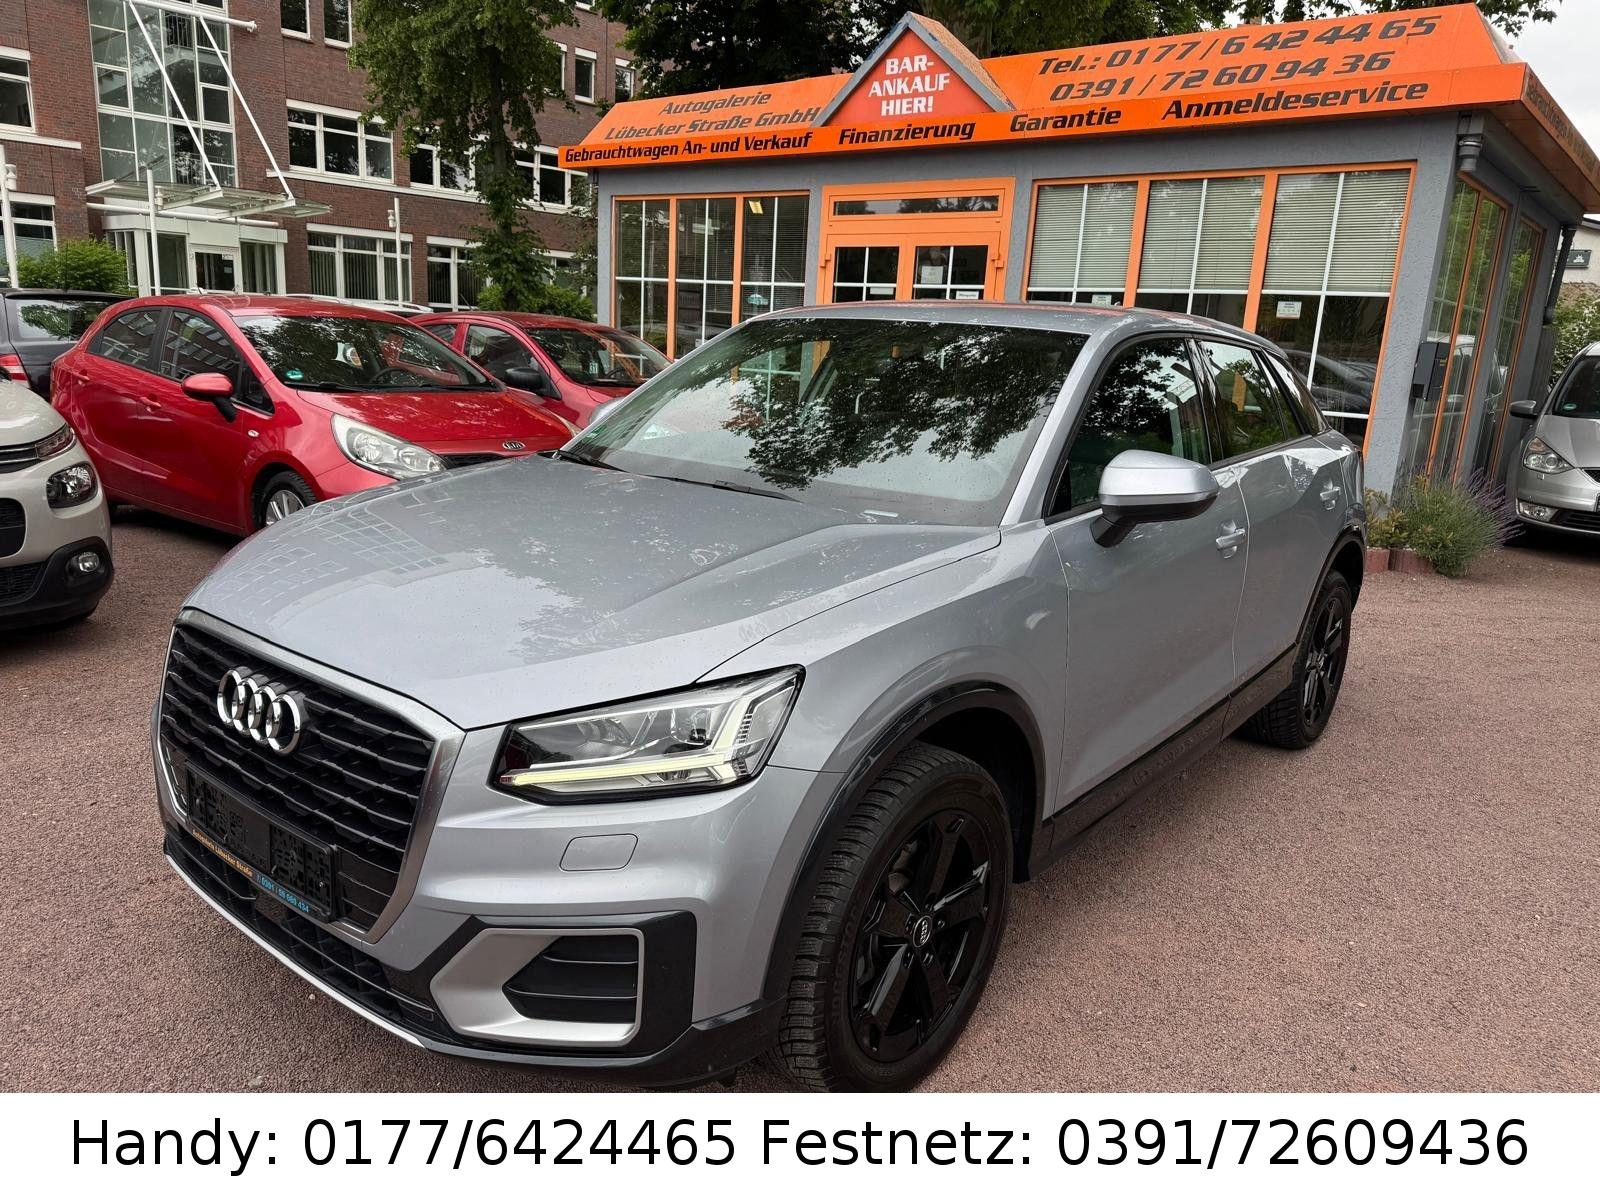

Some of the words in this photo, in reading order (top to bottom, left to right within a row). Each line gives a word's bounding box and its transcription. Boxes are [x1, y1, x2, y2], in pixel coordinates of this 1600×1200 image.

[1039, 54, 1101, 75] Tel.:
[1253, 29, 1309, 51] 42
[1313, 22, 1374, 45] 44
[1378, 15, 1442, 40] 65
[885, 54, 935, 76] BAR-
[1050, 76, 1135, 101] 0391
[1160, 69, 1209, 92] 72
[1213, 63, 1267, 86] 60
[1270, 57, 1329, 81] 94
[1333, 51, 1395, 75] 36
[868, 72, 950, 98] ANKAUF
[658, 91, 772, 116] Autogalerie
[881, 96, 933, 117] HIER!
[565, 142, 678, 163] Gebrauchtwagen
[681, 139, 707, 155] An-
[710, 137, 739, 153] und
[744, 131, 813, 151] Verkauf
[839, 121, 976, 145] Finanzierung
[1009, 106, 1122, 133] Garantie
[1161, 80, 1429, 121] Anmeldeservice
[604, 123, 685, 140] Lübecker
[685, 115, 752, 134] Straße
[754, 106, 821, 127] GmbH
